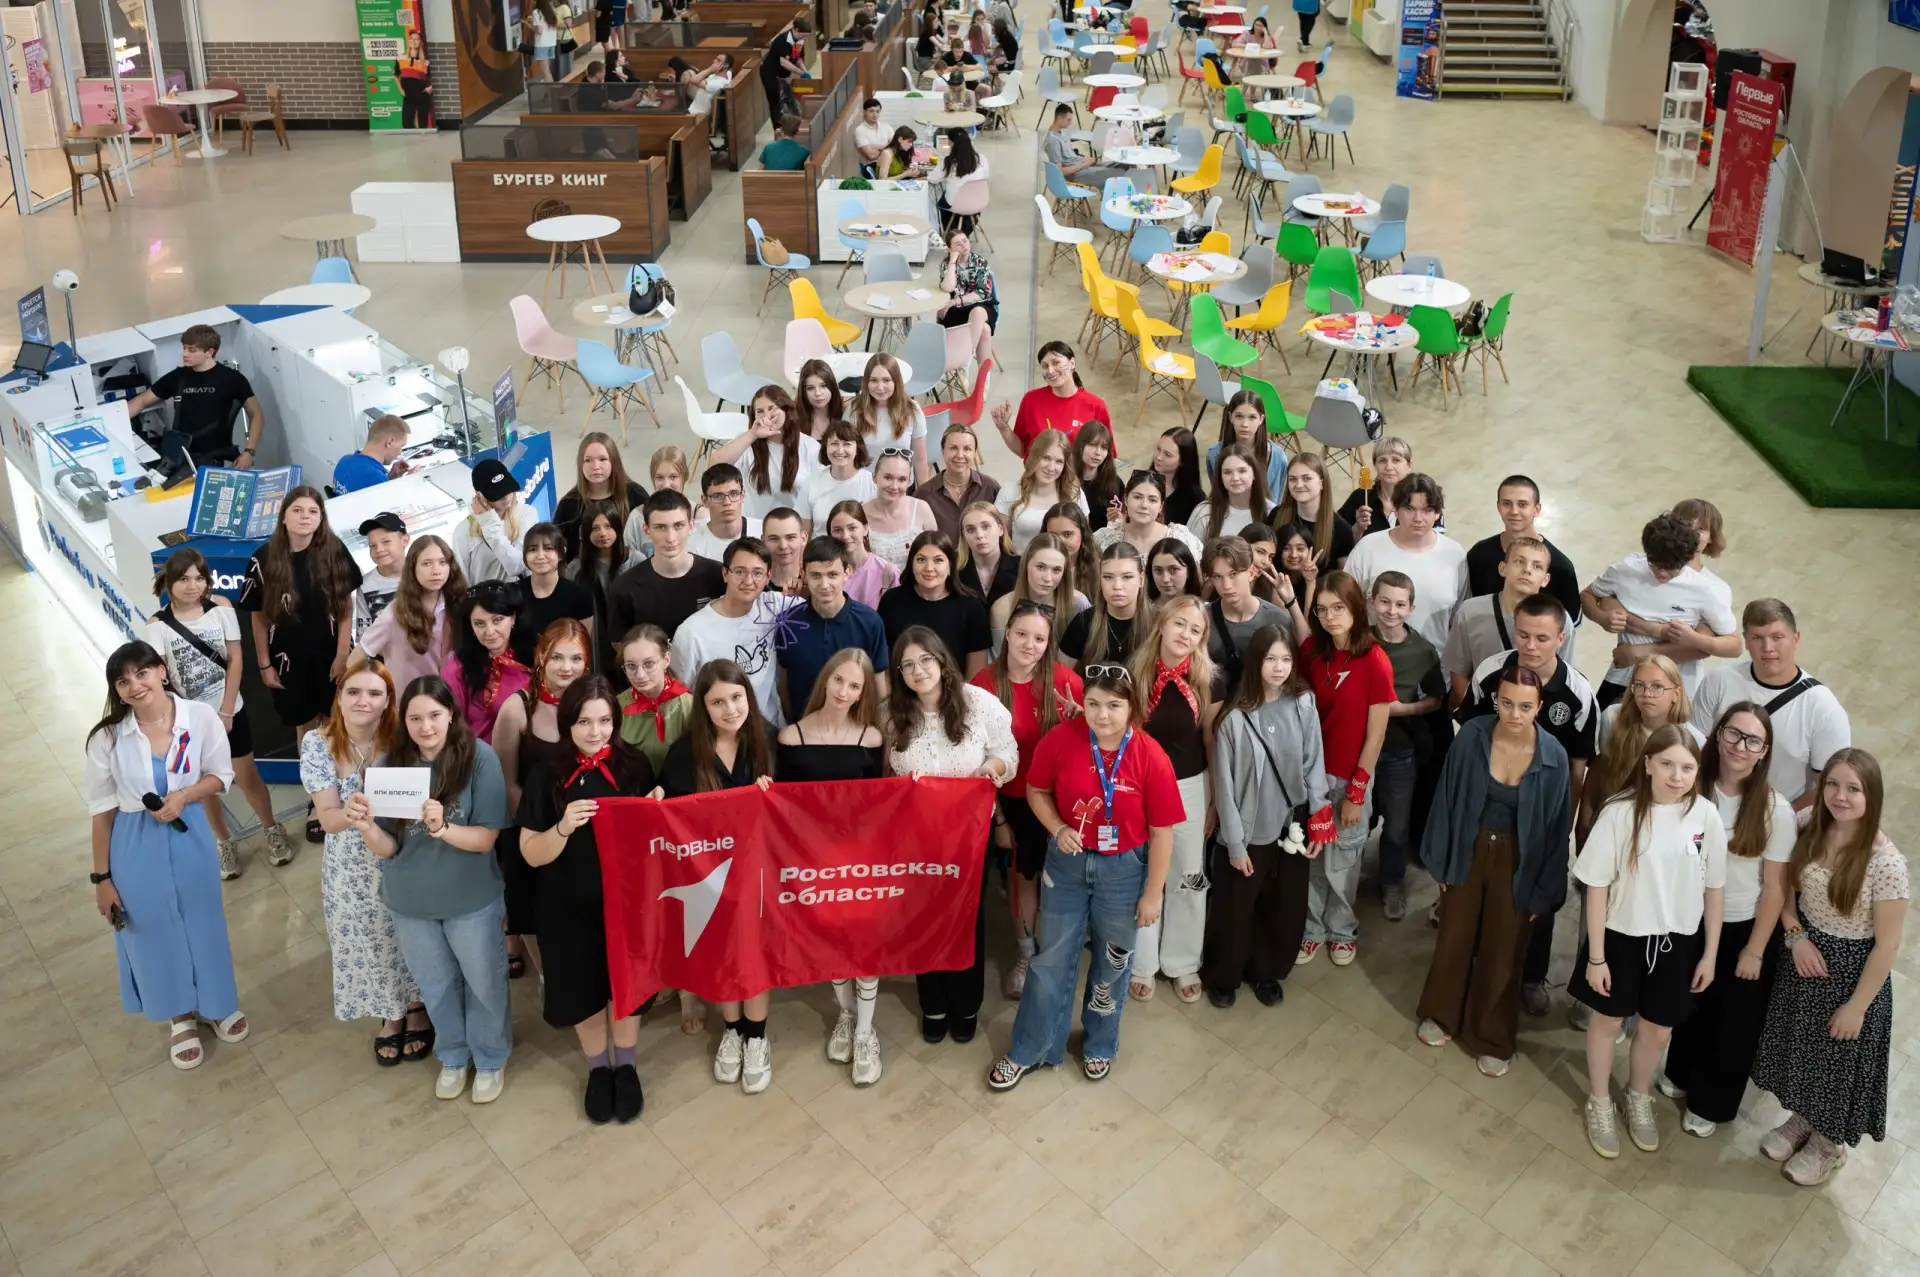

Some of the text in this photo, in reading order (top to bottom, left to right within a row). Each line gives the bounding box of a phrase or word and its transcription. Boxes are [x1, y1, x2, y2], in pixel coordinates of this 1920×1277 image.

[1735, 80, 1775, 105] Первые
[1733, 107, 1772, 126] РОСТОВСКАЯ
[1737, 116, 1764, 131] ОБЛАСТЬ
[493, 173, 608, 186] БУРГЕР КИНГ
[649, 835, 735, 861] Первые
[779, 861, 961, 883] Ростовская
[778, 885, 905, 906] область
